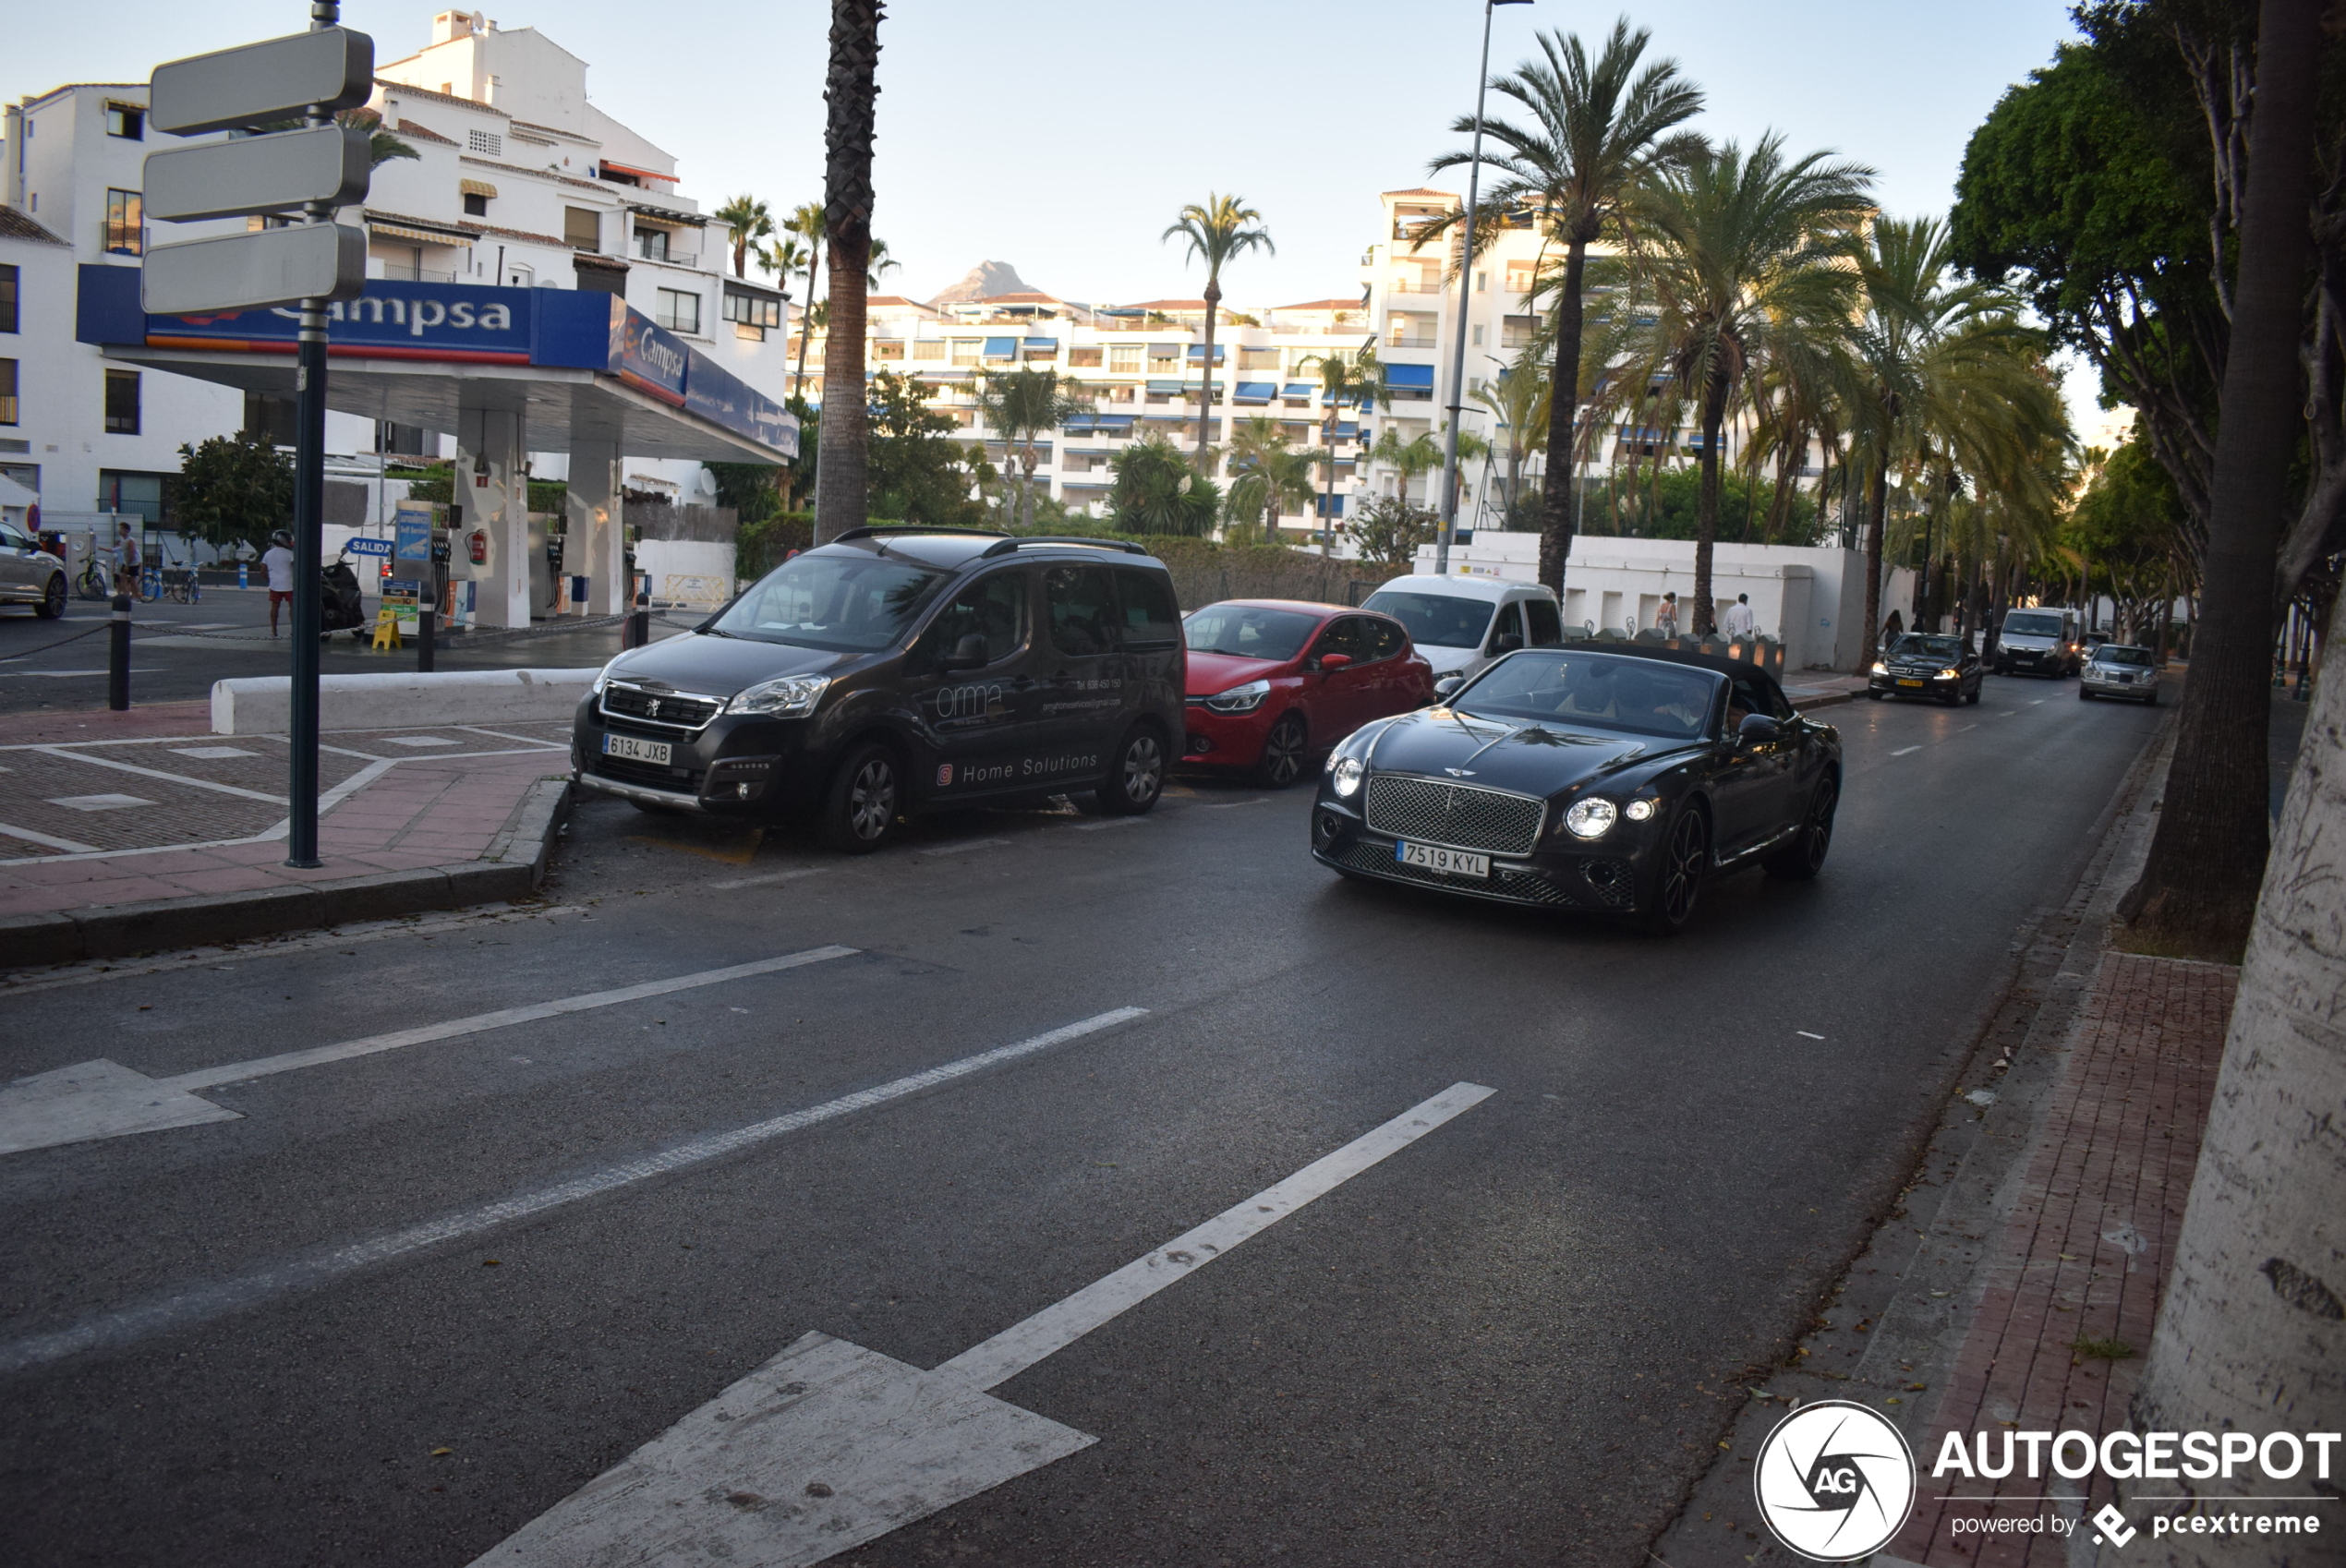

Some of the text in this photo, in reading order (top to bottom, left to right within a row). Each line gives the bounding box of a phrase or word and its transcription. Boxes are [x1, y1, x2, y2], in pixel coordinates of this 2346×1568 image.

[640, 326, 683, 379] Campsa
[353, 541, 392, 554] SALIDA
[1099, 679, 1110, 689] 450
[1111, 678, 1121, 688] 150
[937, 685, 1002, 718] orma
[611, 738, 668, 762] 6134 JXB
[963, 754, 1097, 783] Home Solutions
[1407, 845, 1485, 874] 7519 KYL
